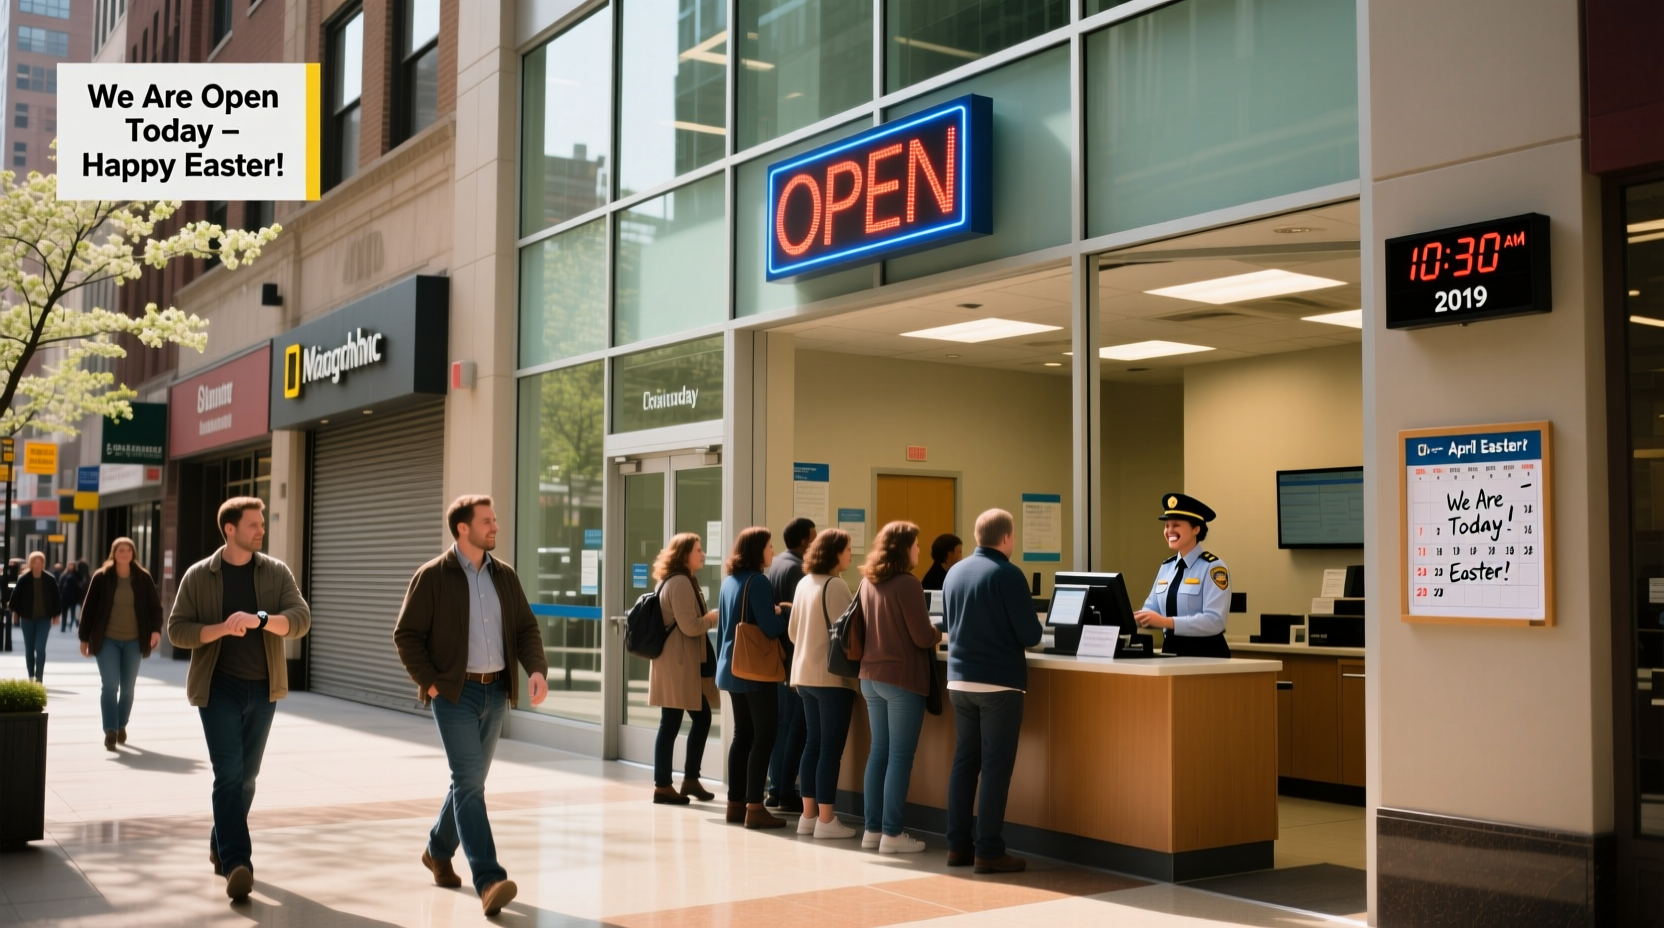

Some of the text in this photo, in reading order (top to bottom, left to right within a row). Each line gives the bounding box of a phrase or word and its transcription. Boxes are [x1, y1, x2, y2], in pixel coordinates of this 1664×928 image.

[776, 126, 956, 256] OPEN
[1410, 231, 1525, 281] 10:30 AM
[1435, 285, 1488, 313] 2019
[1447, 488, 1504, 511] We Are
[1450, 561, 1510, 583] Easter!
